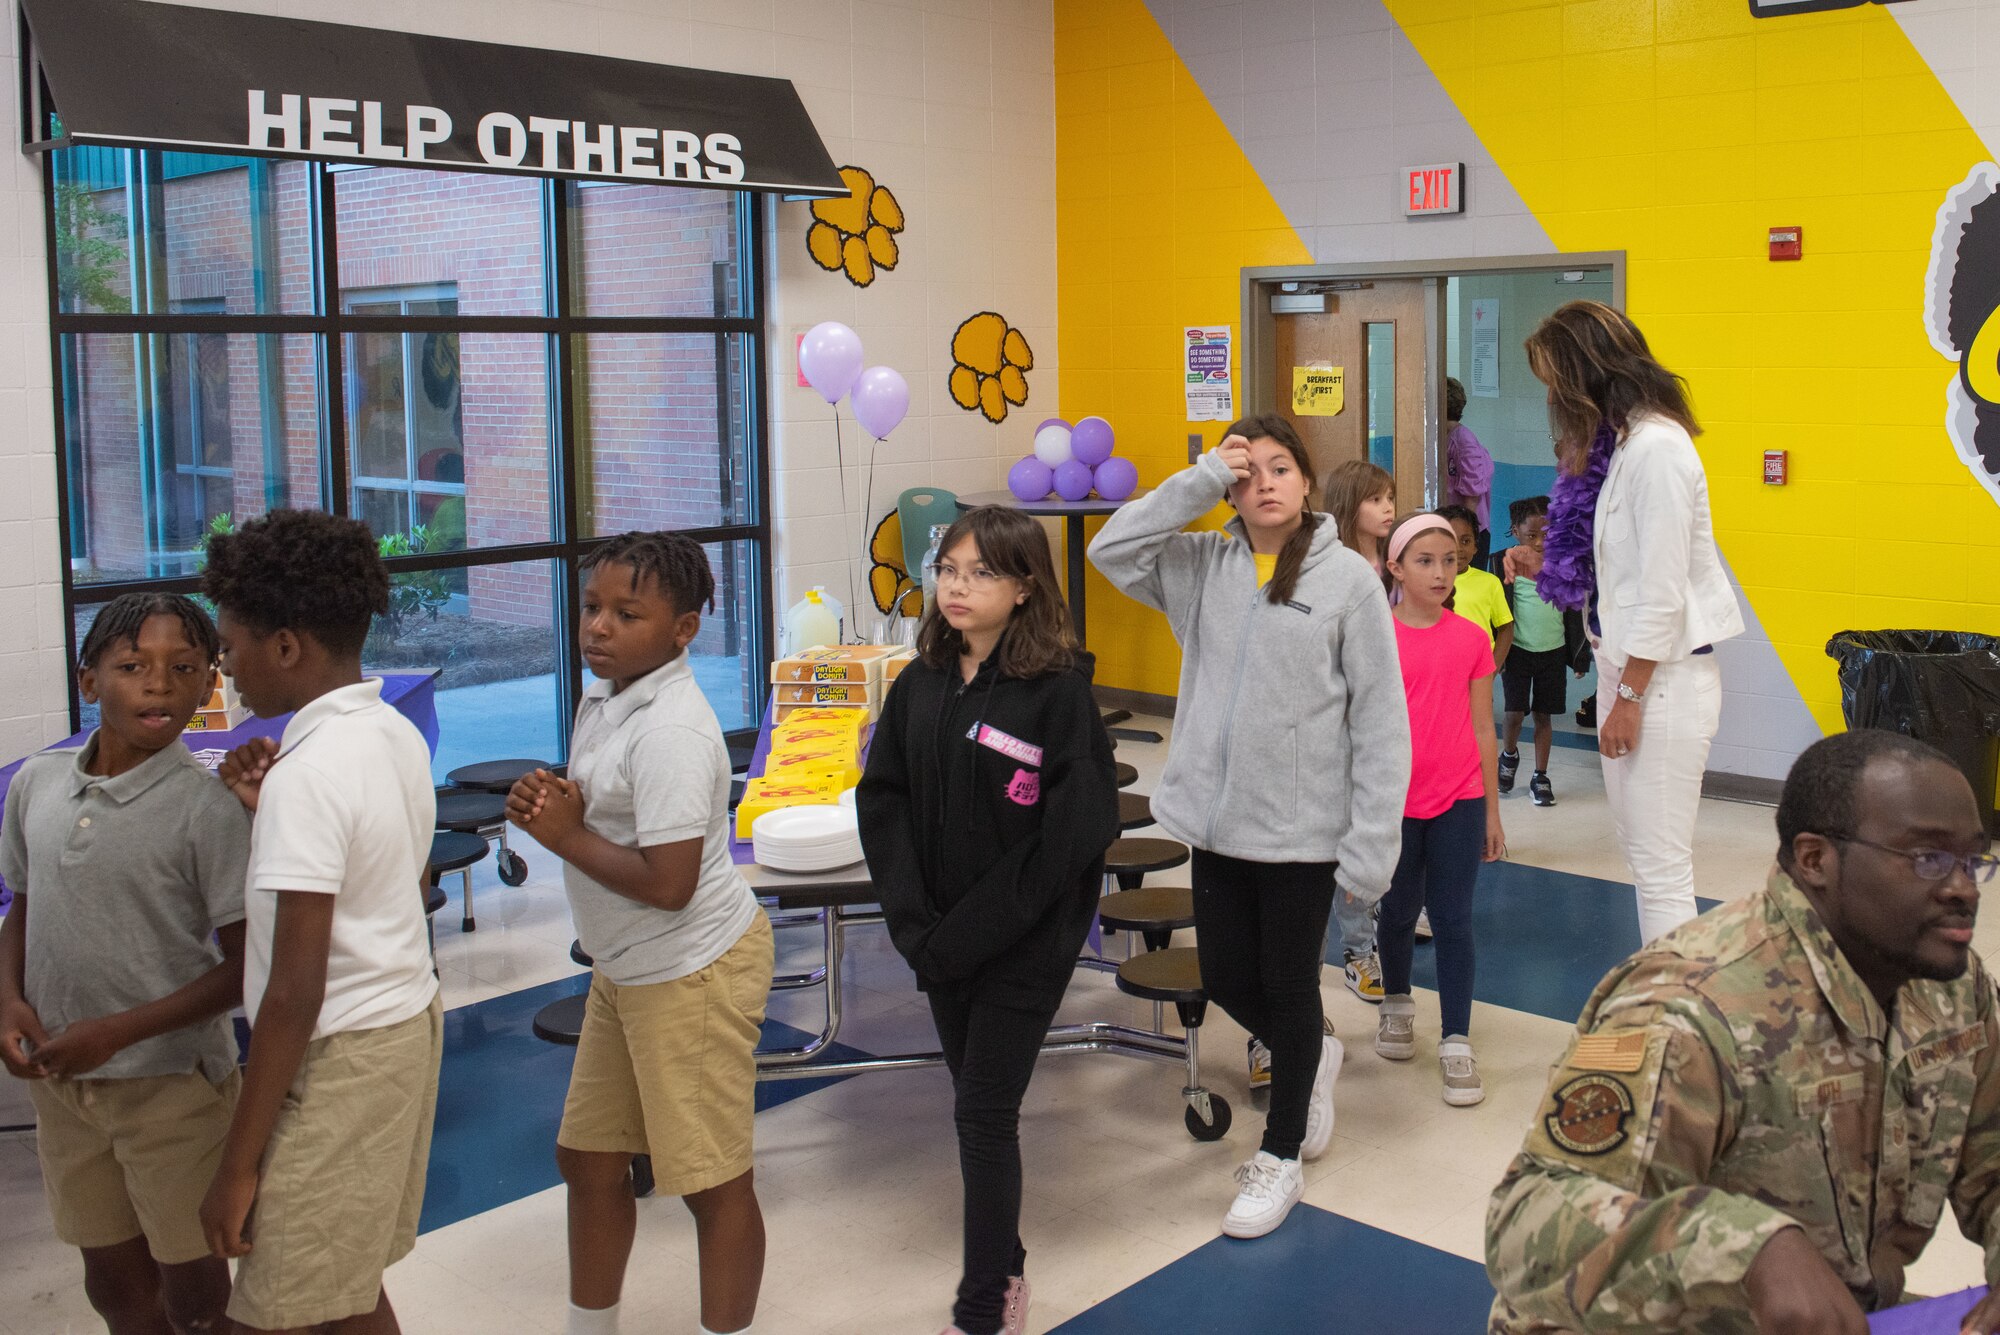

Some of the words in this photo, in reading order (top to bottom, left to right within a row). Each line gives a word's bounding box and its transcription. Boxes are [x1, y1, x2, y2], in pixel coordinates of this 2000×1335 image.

[248, 89, 453, 160] HELP
[477, 111, 745, 183] OTHERS
[1409, 169, 1452, 210] EXIT
[1306, 376, 1341, 384] BREAKFAST
[1315, 386, 1332, 394] FIRST
[1765, 461, 1782, 469] FIRE
[815, 665, 847, 674] DAYLIGHT
[983, 736, 1005, 749] AND
[987, 730, 1017, 747] HELLO
